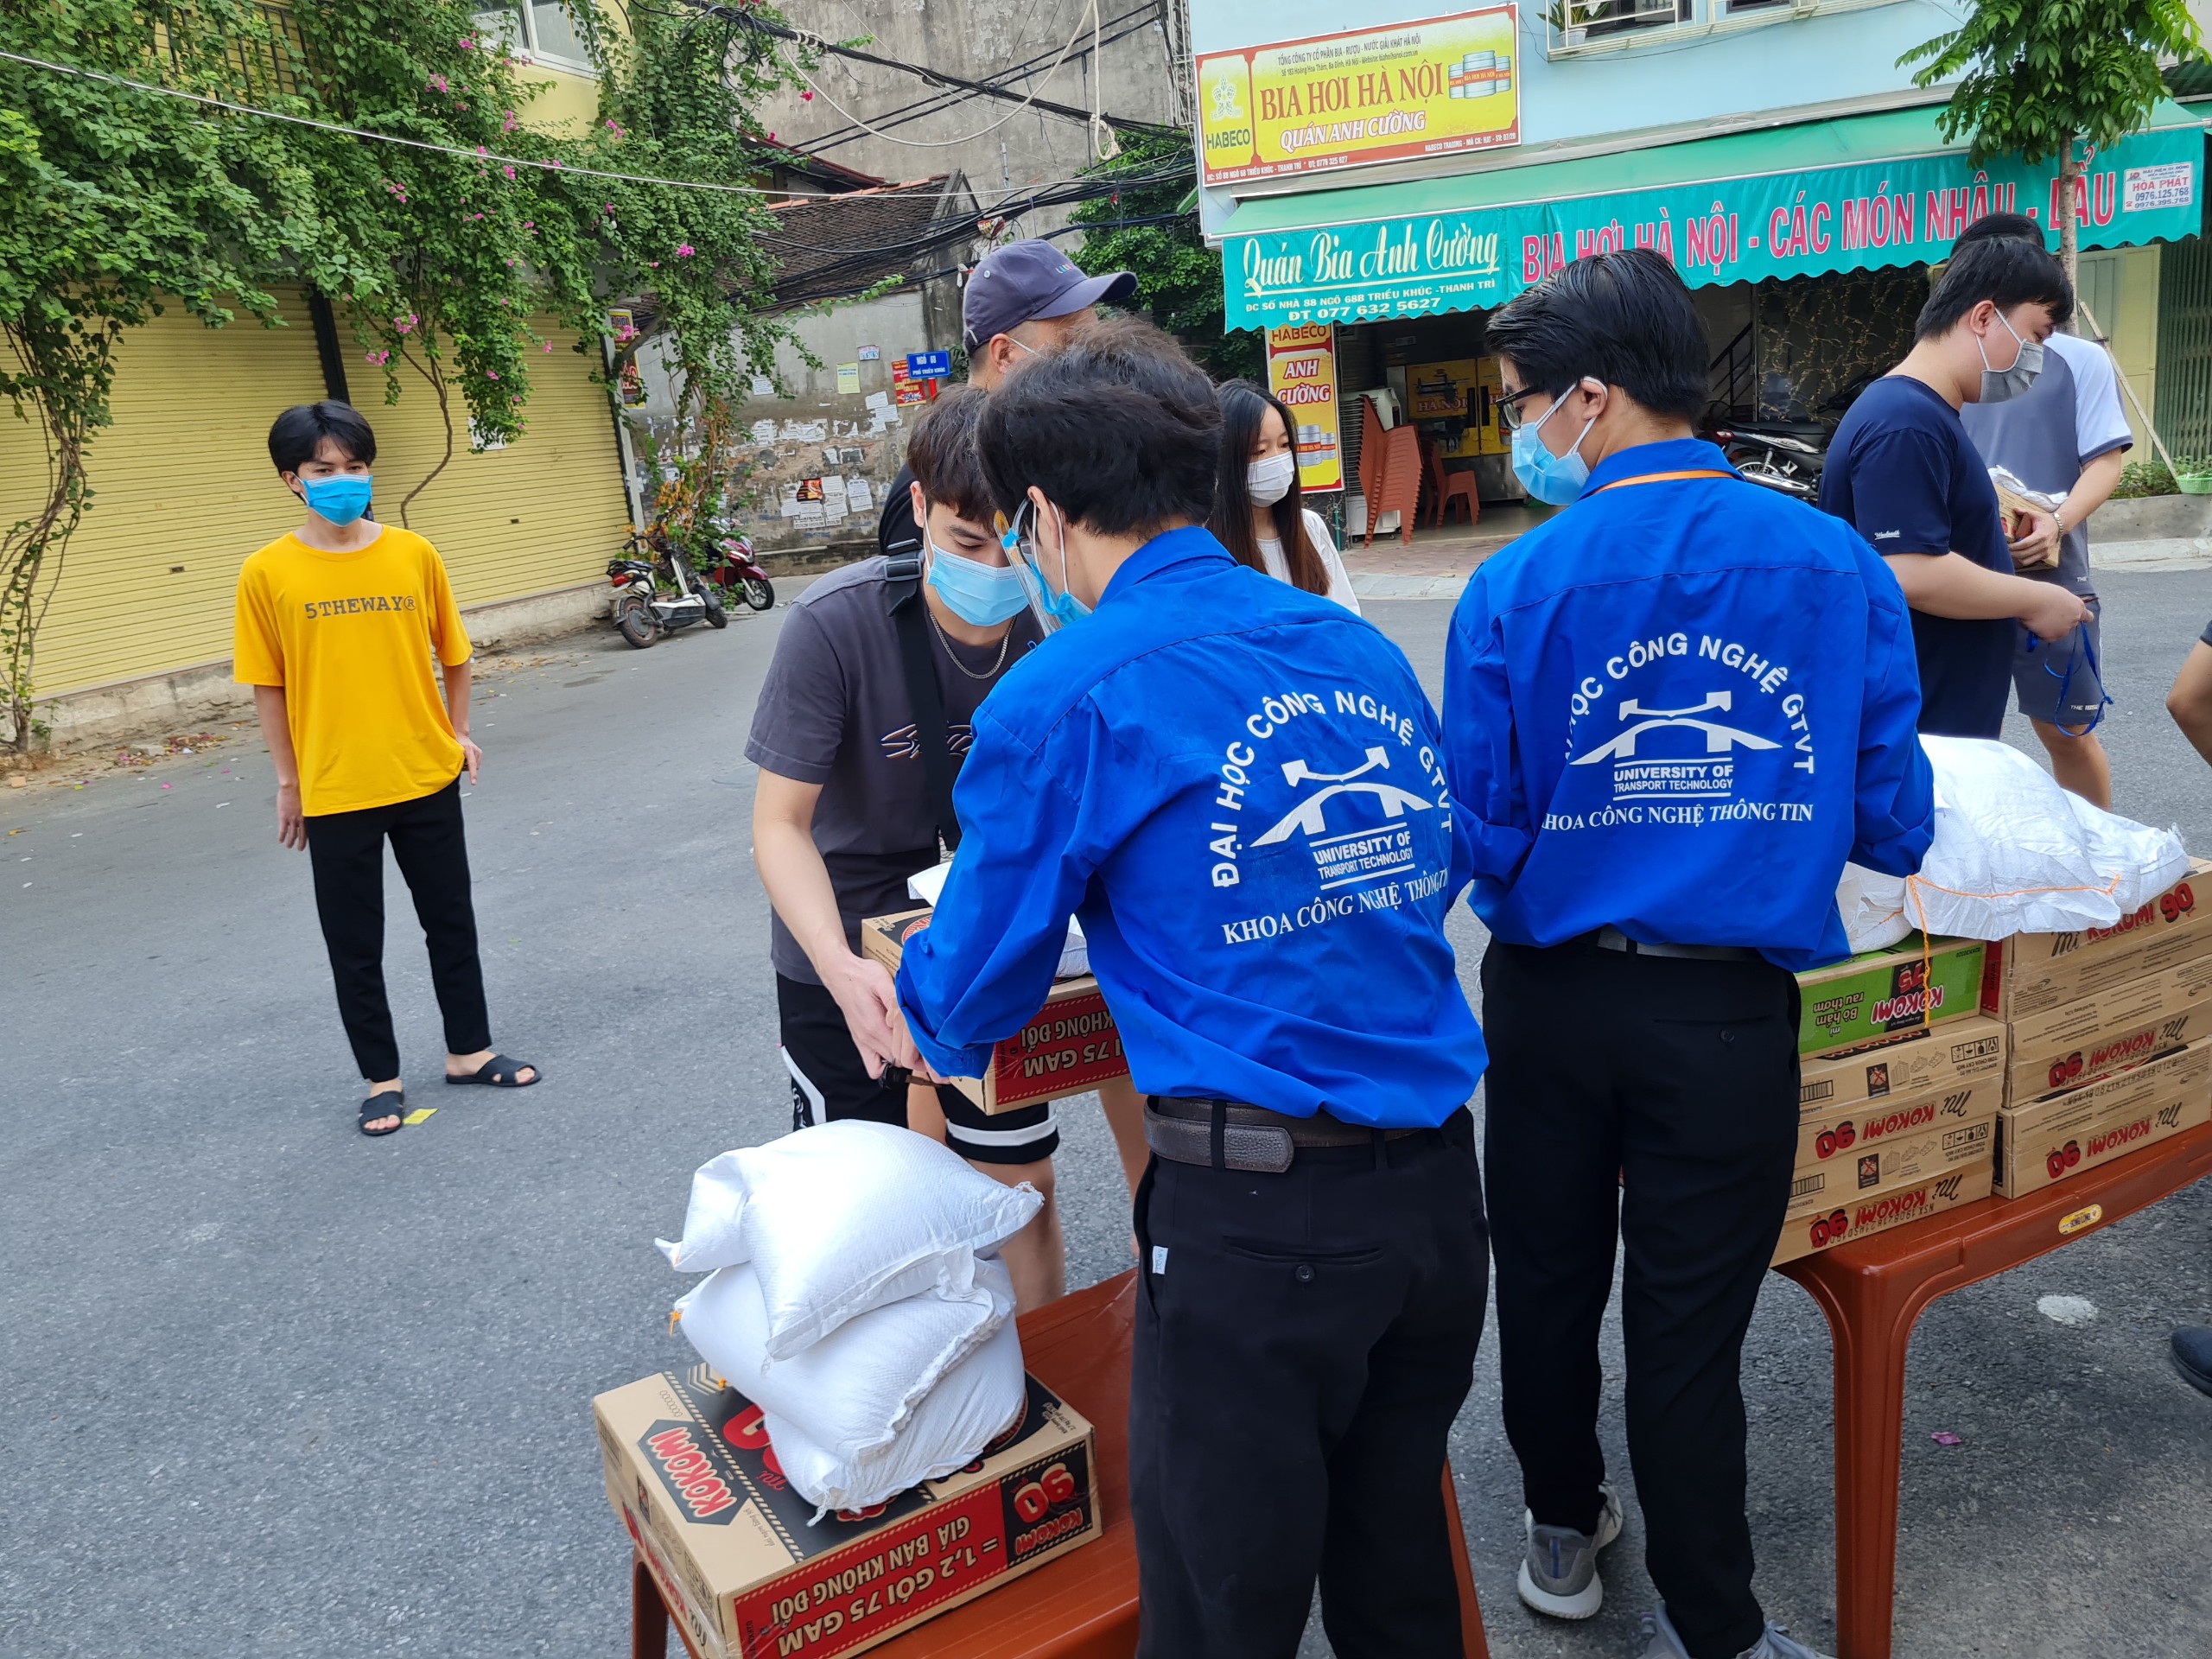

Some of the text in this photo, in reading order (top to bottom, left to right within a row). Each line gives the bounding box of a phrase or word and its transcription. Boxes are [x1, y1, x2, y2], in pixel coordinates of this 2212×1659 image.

[1334, 47, 1343, 57] BIA
[1261, 58, 1444, 122] BIA HƠI HÀ NỘI
[1205, 128, 1250, 150] HABECO
[1280, 109, 1426, 154] QUÁN ANH CƯỜNG
[2132, 175, 2190, 192] HÒA PHÁT
[2135, 187, 2190, 201] 0976.125.768
[1522, 231, 1566, 284] BIA
[1686, 200, 1738, 276] NỘI
[1768, 190, 1832, 259] CÁC
[1840, 180, 1915, 251] MÓN
[1243, 218, 1501, 299] Quán Bia Anh Cường
[1245, 303, 1259, 313] ĐC
[1262, 298, 1276, 311] SỐ
[1279, 296, 1300, 309] NHÀ
[1303, 298, 1317, 308] 88
[1319, 295, 1341, 307] NGÕ
[1344, 294, 1365, 303] 68B
[1402, 284, 1433, 298] KHÚC
[1477, 277, 1496, 291] TRÌ
[1288, 297, 1441, 322] ĐT 077 632 5627
[1271, 324, 1327, 342] HABECO
[1282, 358, 1320, 380] ANH
[1276, 382, 1332, 406] CƯỜNG
[1606, 632, 1688, 680] CÔNG
[1698, 635, 1789, 695] NGHỆ
[1782, 693, 1815, 774] GTVT
[1209, 690, 1452, 887] ĐẠI HỌC CÔNG NGHỆ GTVT
[1614, 765, 1734, 782] UNIVERSITY OF
[1614, 778, 1733, 794] TRANSPORT TECHNOLOGY
[1588, 804, 1643, 828] CÔNG
[1648, 804, 1705, 828] NGHỆ
[1709, 798, 1777, 823] THÔNG
[1779, 803, 1814, 822] TIN
[1313, 830, 1411, 865] UNIVERSITY OF
[1318, 846, 1414, 880] TRANSPORT TECHNOLOGY
[1222, 912, 1295, 945] KHOA
[1296, 895, 1353, 928] CÔNG
[1358, 881, 1402, 914] NGHỆ
[1405, 870, 1440, 903] THÔNG
[2160, 882, 2195, 924] 90
[1897, 961, 1924, 994] 75
[1813, 991, 1865, 1014] rau thơm
[1842, 1007, 1859, 1025] Bò
[1870, 984, 1944, 1025] KOKOMI
[1020, 1008, 1115, 1054] KHÔNG ĐỔI
[1829, 1026, 1841, 1038] mì
[2088, 1028, 2158, 1068] KOKOMI
[1023, 1048, 1078, 1079] GAM
[1083, 1039, 1110, 1064] 75
[2048, 1051, 2083, 1088] 90
[1815, 1090, 1973, 1160] Mì KOKOMI 90
[2086, 1116, 2152, 1158] KOKOMI
[2046, 1139, 2082, 1179] 90
[1809, 1173, 1963, 1249] Mì KOKOMI 90
[646, 1427, 737, 1518] KOKOMI
[1014, 1462, 1076, 1523] 90
[1014, 1506, 1084, 1555] KOKOMI
[771, 1515, 970, 1630] GIÁ BÁN KHÔNG ĐỔI
[887, 1567, 935, 1605] GÓI
[849, 1588, 882, 1624] 75
[778, 1608, 845, 1658] GAM
